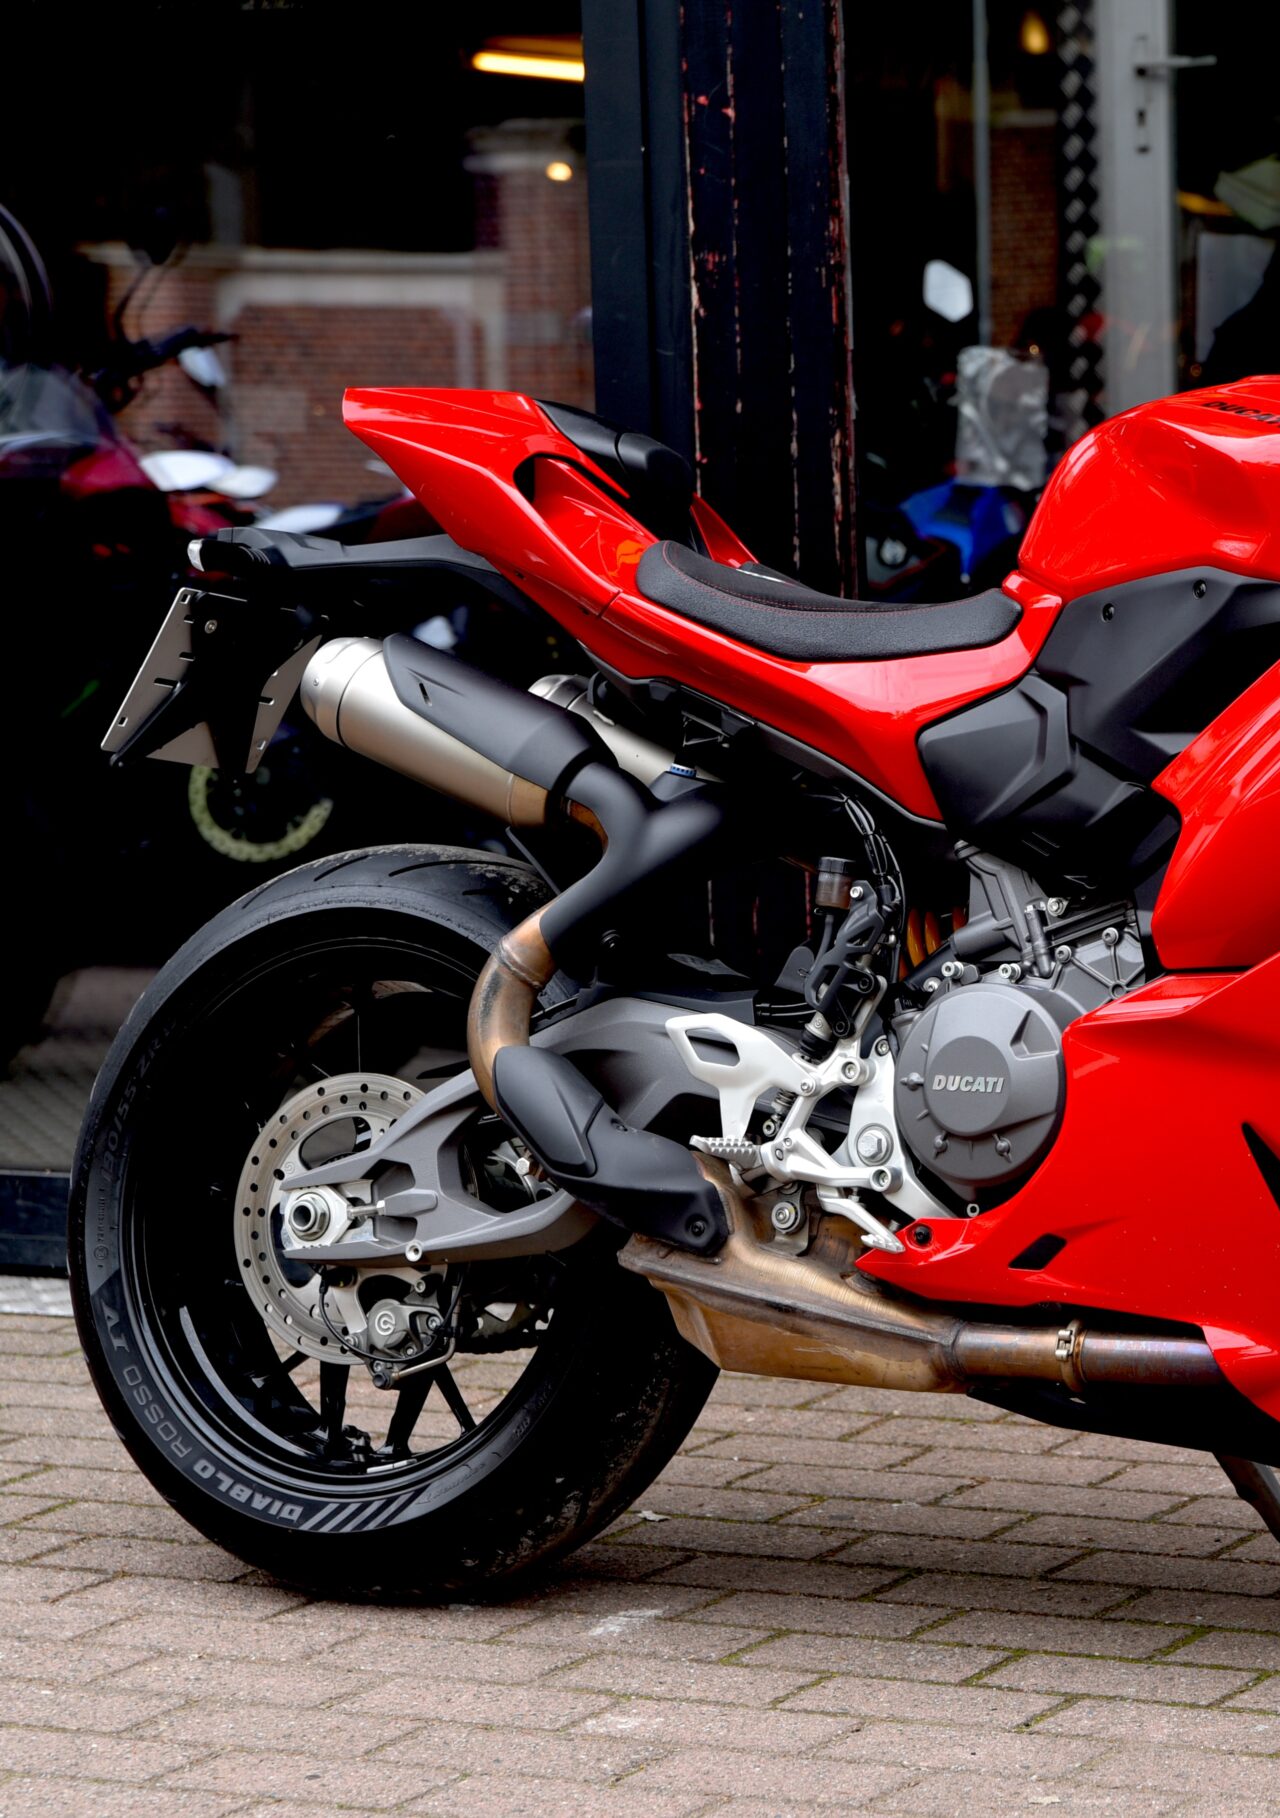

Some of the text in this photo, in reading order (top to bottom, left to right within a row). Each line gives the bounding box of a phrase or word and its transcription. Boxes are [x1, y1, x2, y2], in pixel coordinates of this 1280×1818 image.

[932, 1075, 1004, 1093] DUCATI
[123, 1365, 192, 1458] ROSSO
[193, 1458, 304, 1525] DIABLO
